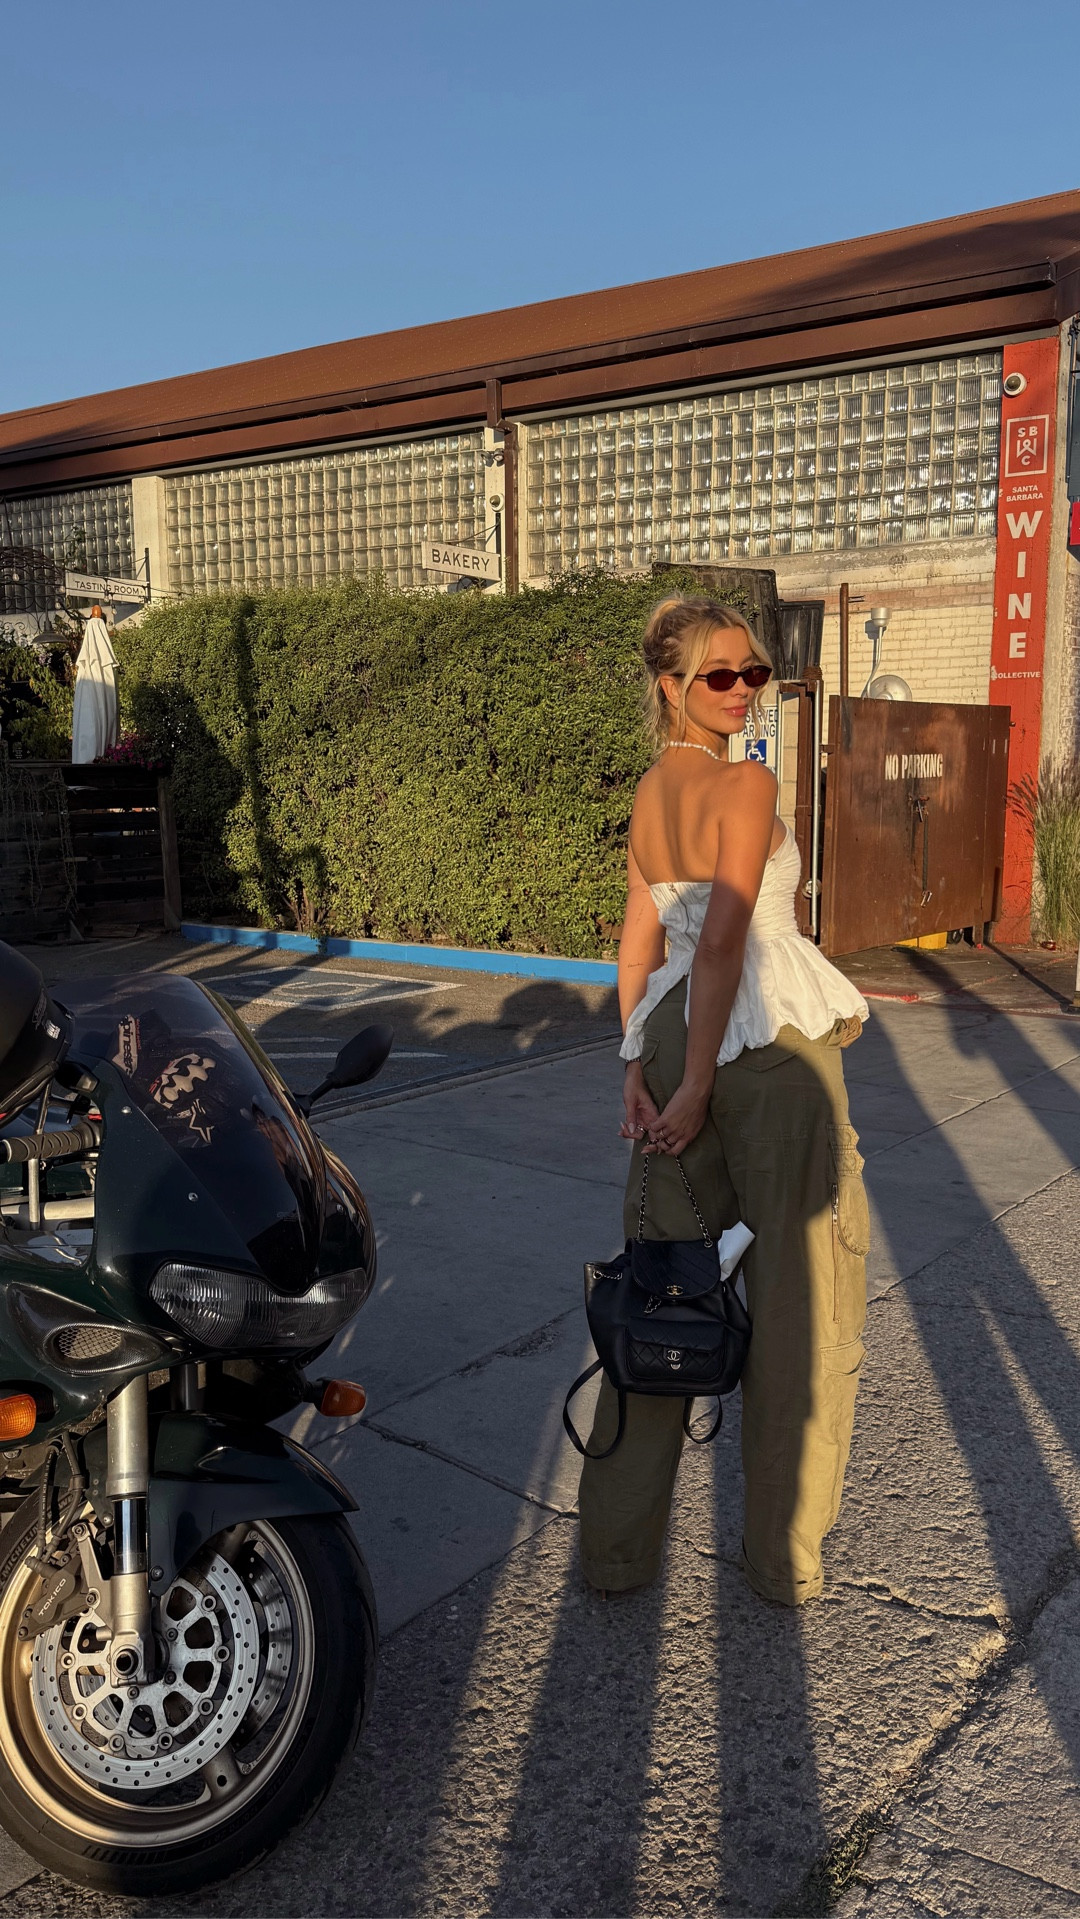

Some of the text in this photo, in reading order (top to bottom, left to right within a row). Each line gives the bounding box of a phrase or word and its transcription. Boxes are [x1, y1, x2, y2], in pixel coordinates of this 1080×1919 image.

[1006, 492, 1043, 502] BARBARA
[1012, 485, 1038, 494] SANTA
[431, 548, 490, 572] BAKERY
[74, 580, 140, 595] TASTING ROOM
[1005, 510, 1043, 659] WINE
[992, 671, 1041, 679] OLLECTIVE
[738, 723, 776, 738] ARING
[885, 753, 943, 780] NO PARKING
[1, 1522, 39, 1578] MICHELIN
[38, 1578, 66, 1616] TOKICO
